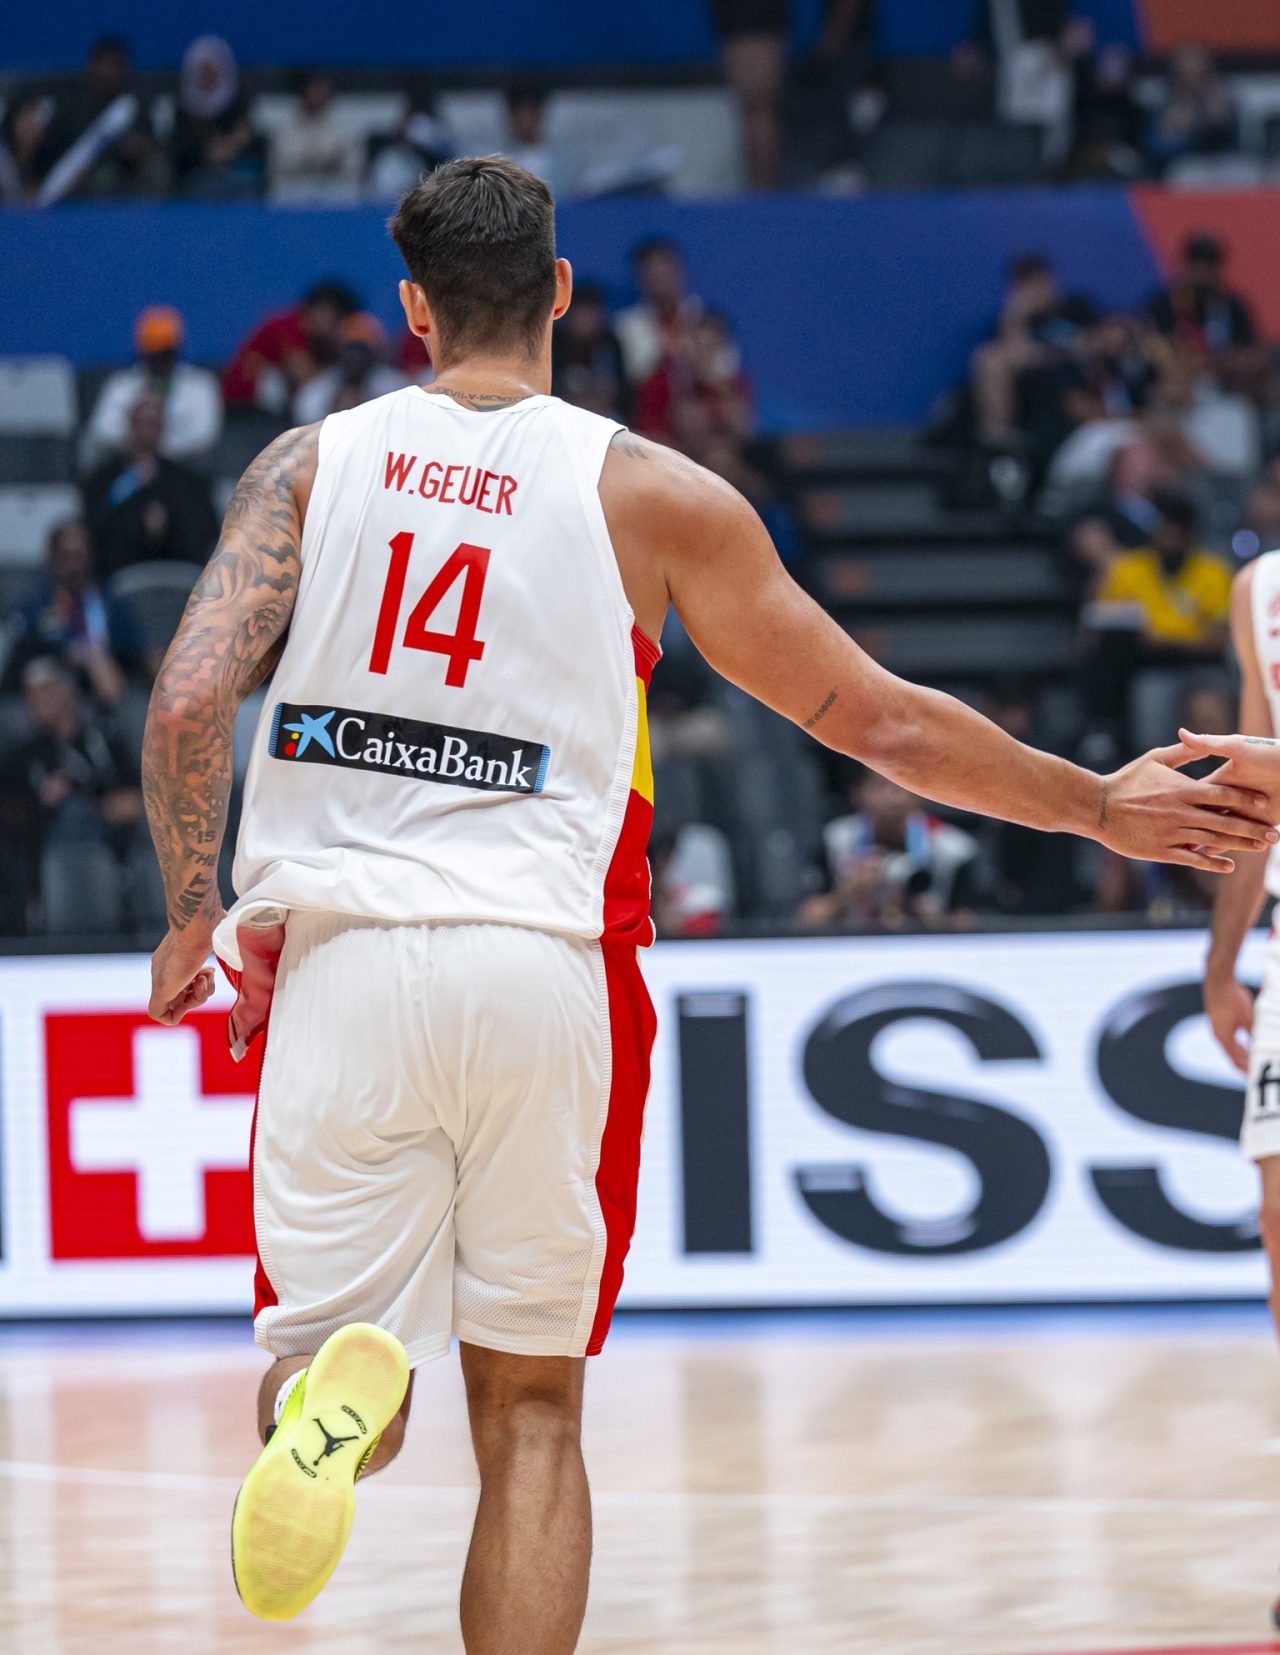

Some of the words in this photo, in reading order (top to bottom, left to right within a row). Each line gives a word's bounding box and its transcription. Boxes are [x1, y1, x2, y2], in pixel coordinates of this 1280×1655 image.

[385, 451, 517, 516] W.GEUER
[368, 531, 491, 688] 14
[335, 717, 533, 788] CaixaBank
